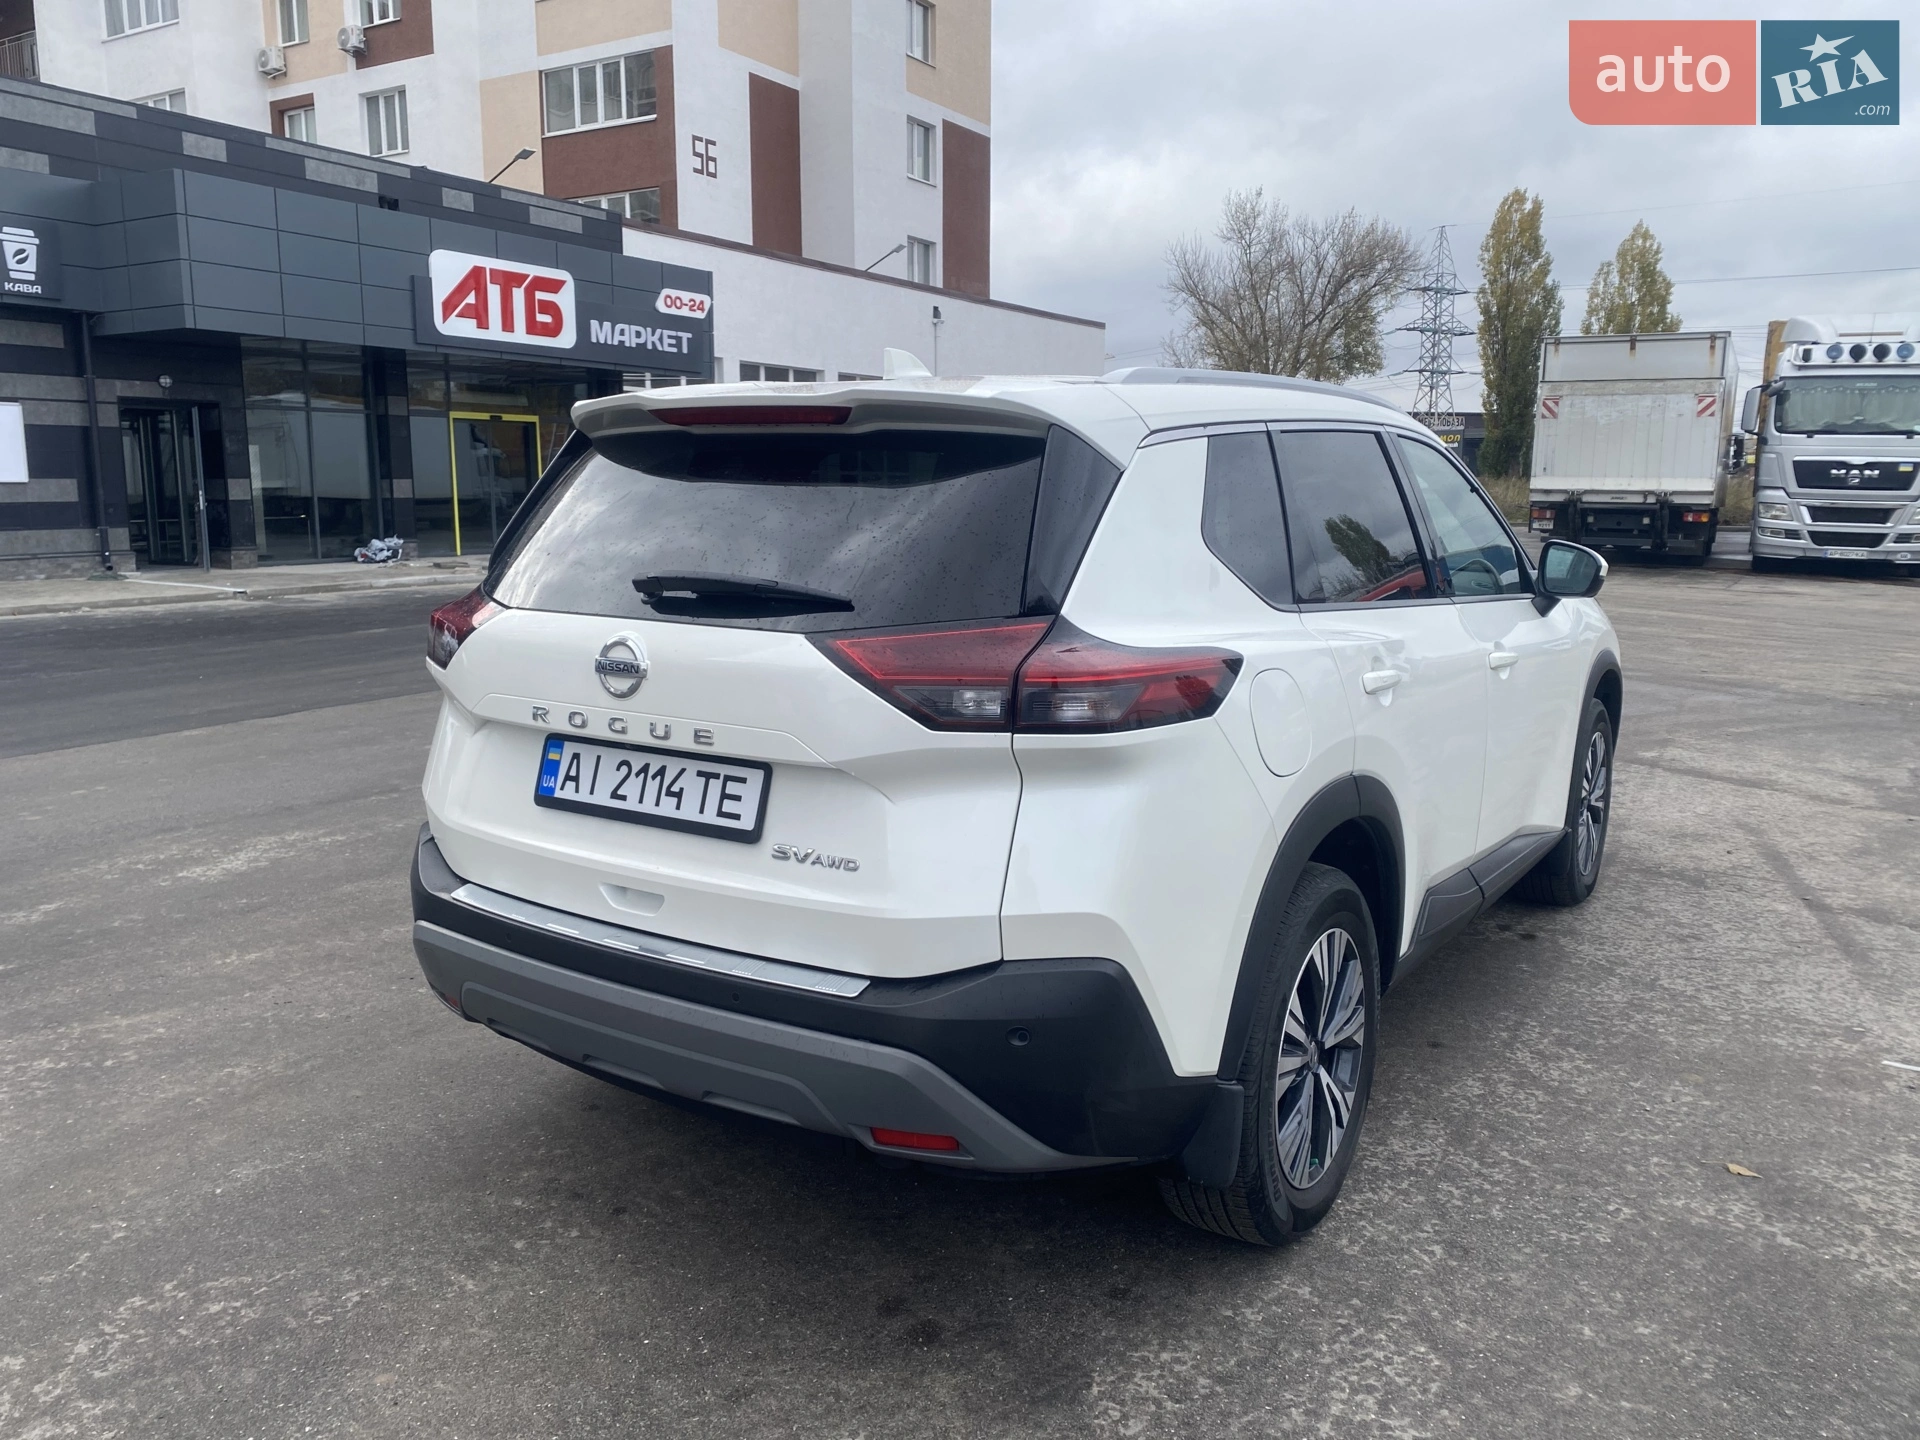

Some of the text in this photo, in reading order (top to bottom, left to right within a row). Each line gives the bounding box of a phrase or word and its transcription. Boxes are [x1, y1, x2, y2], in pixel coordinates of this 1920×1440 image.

[691, 134, 718, 179] 56
[4, 281, 42, 294] КАВА
[441, 264, 568, 339] АТБ
[663, 294, 706, 314] 00-24
[589, 319, 693, 354] МАРКЕТ
[1830, 469, 1880, 478] MAN
[597, 659, 640, 675] NISSAN
[532, 705, 715, 746] ROGUE
[543, 775, 555, 789] UA
[559, 752, 748, 821] AI 2114 TE
